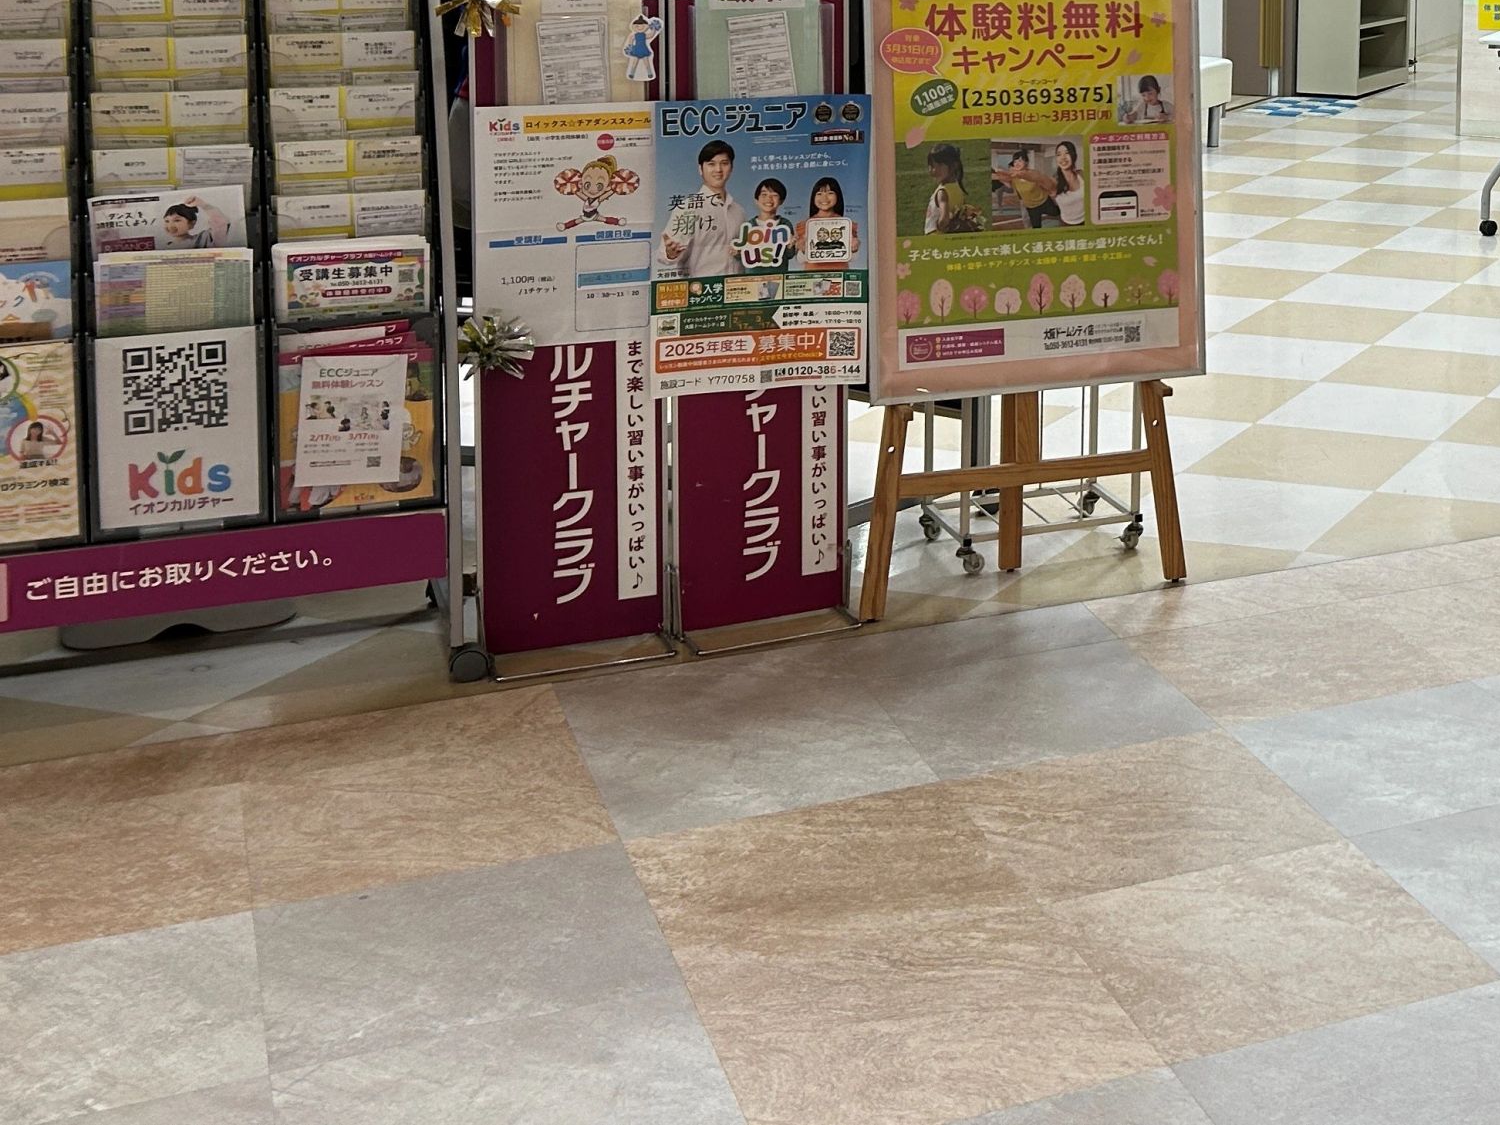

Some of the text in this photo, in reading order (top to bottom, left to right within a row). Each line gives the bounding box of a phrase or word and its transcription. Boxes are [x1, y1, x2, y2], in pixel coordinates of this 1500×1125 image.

[924, 0, 1145, 42] 体験料無料
[951, 42, 1121, 74] キャンペーン
[489, 118, 521, 132] Kids
[668, 192, 724, 211] 英語で、
[734, 221, 788, 247] Join
[744, 243, 783, 265] us!
[299, 265, 393, 282] 受講生募集中
[664, 339, 748, 358] 2025年度生
[758, 331, 825, 355] 募集中!
[319, 366, 379, 378] ECCジュニア
[660, 374, 755, 390] 施設コード Y770758
[311, 379, 384, 390] 無料体験レッスン
[128, 454, 232, 501] Kids
[129, 495, 235, 517] イオンカルチャー
[26, 549, 334, 601] ご自由にお取りください。
